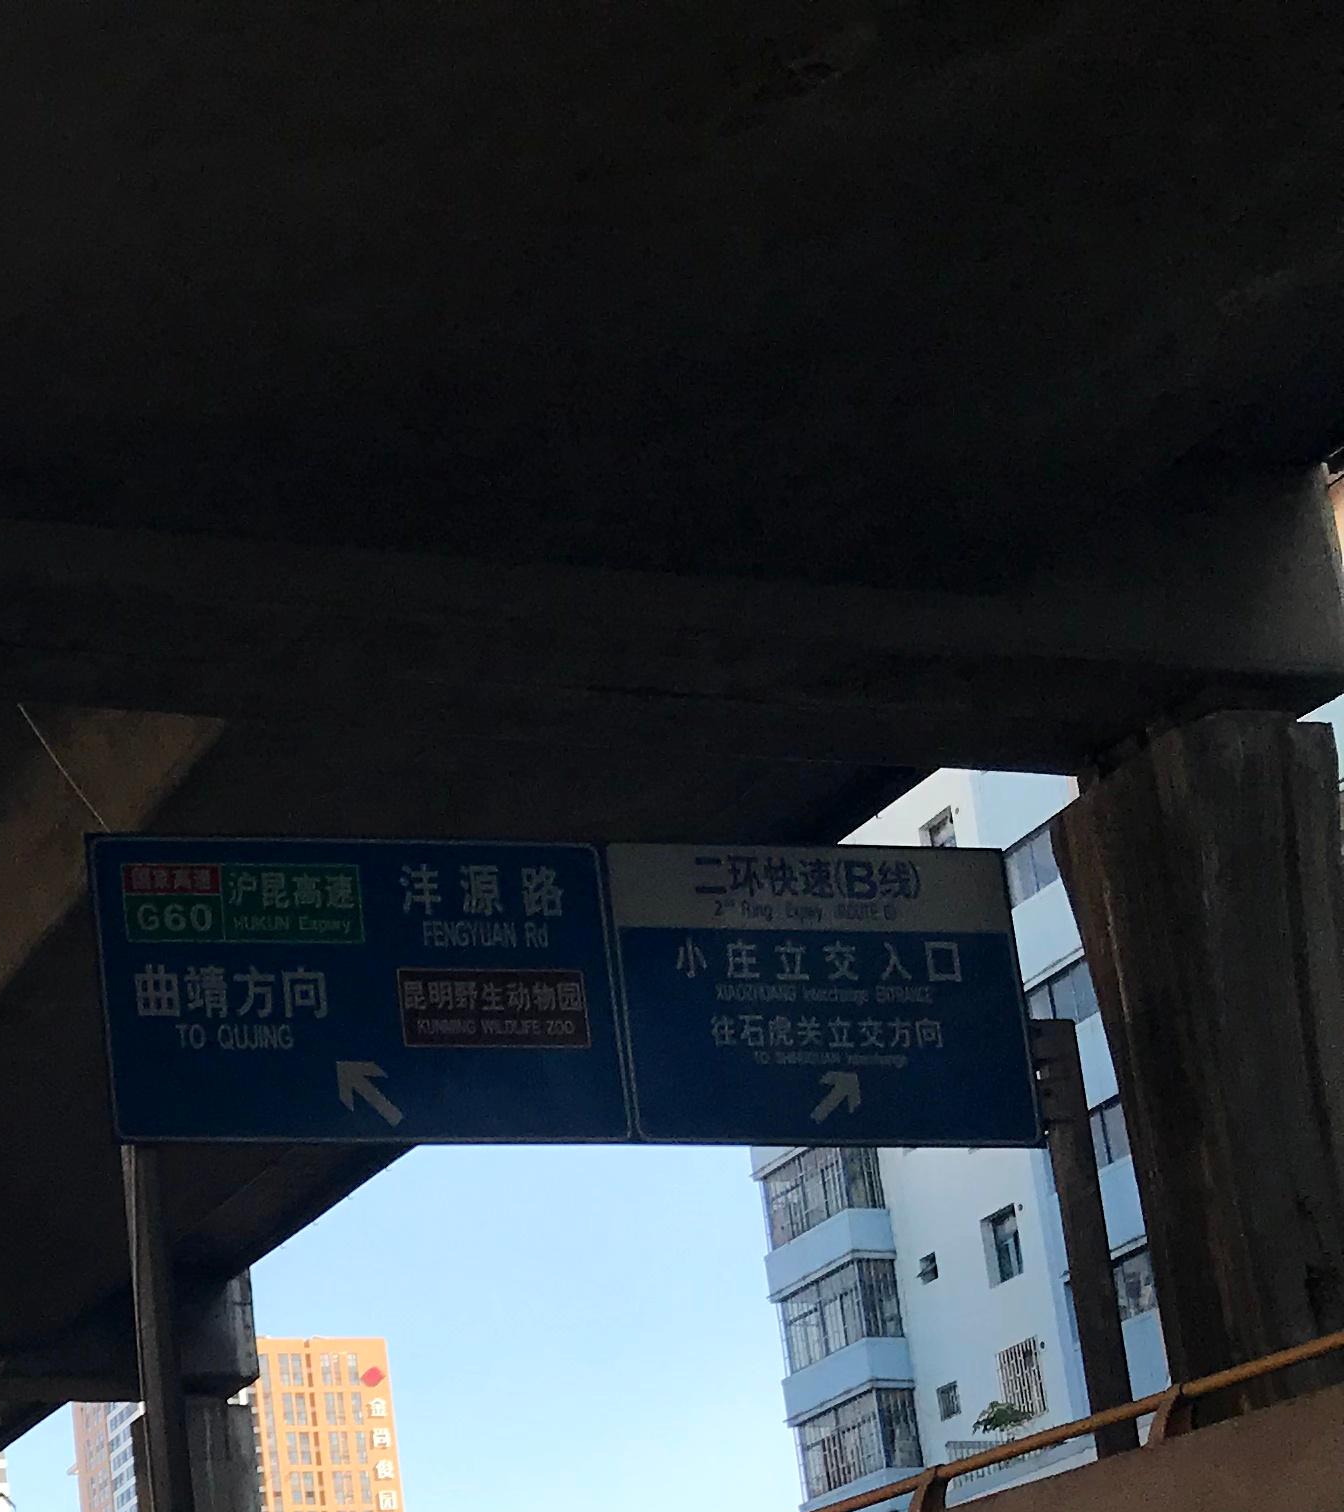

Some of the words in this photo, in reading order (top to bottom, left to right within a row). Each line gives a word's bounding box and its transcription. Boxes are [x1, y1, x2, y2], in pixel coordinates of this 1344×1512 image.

[228, 872, 355, 909] 沪昆高速
[136, 903, 213, 932] G60
[233, 916, 289, 931] HUKUN
[423, 920, 516, 947] FENGYUAN
[524, 921, 549, 948] Rd
[676, 936, 962, 982] 小庄立交入口
[134, 964, 328, 1019] 曲靖方向
[403, 981, 581, 1011] 昆明野生动物园
[176, 1024, 206, 1049] TO
[217, 1024, 294, 1050] QUJING
[417, 1019, 476, 1034] KUNMING
[480, 1019, 540, 1035] WILDLIFE
[546, 1020, 575, 1035] ZOO
[710, 1013, 943, 1048] 往石虎关立交方向
